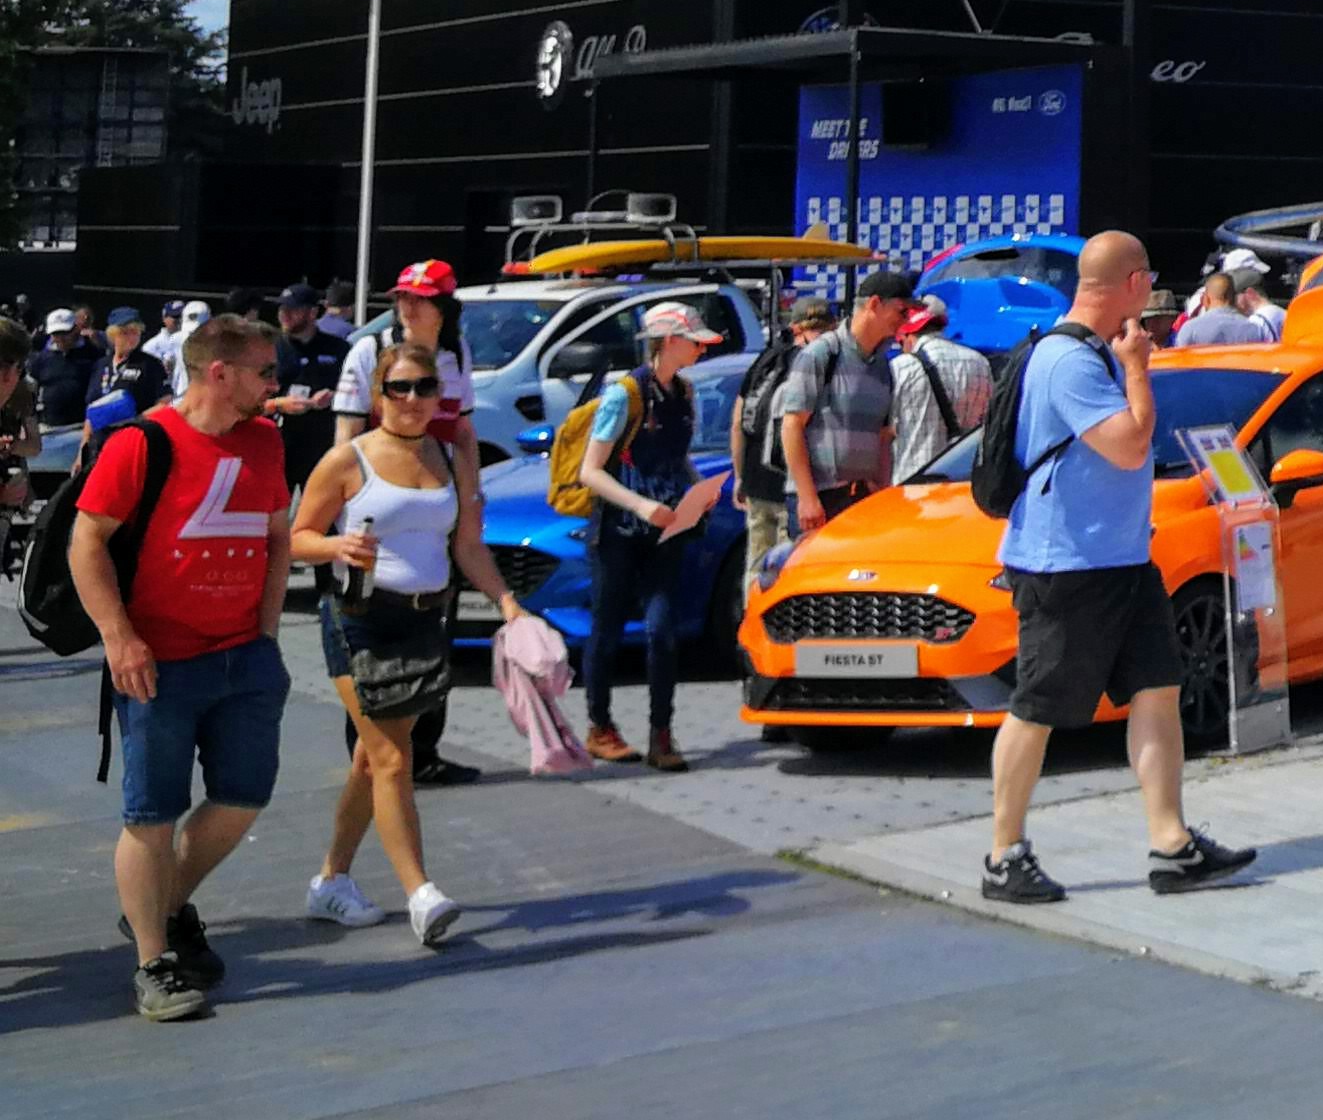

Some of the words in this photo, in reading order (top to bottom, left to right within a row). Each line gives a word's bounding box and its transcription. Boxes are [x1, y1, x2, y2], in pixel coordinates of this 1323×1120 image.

[232, 66, 281, 134] Jeep
[828, 140, 880, 160] DRIERS
[825, 654, 866, 666] FIESTA
[868, 654, 884, 666] ST
